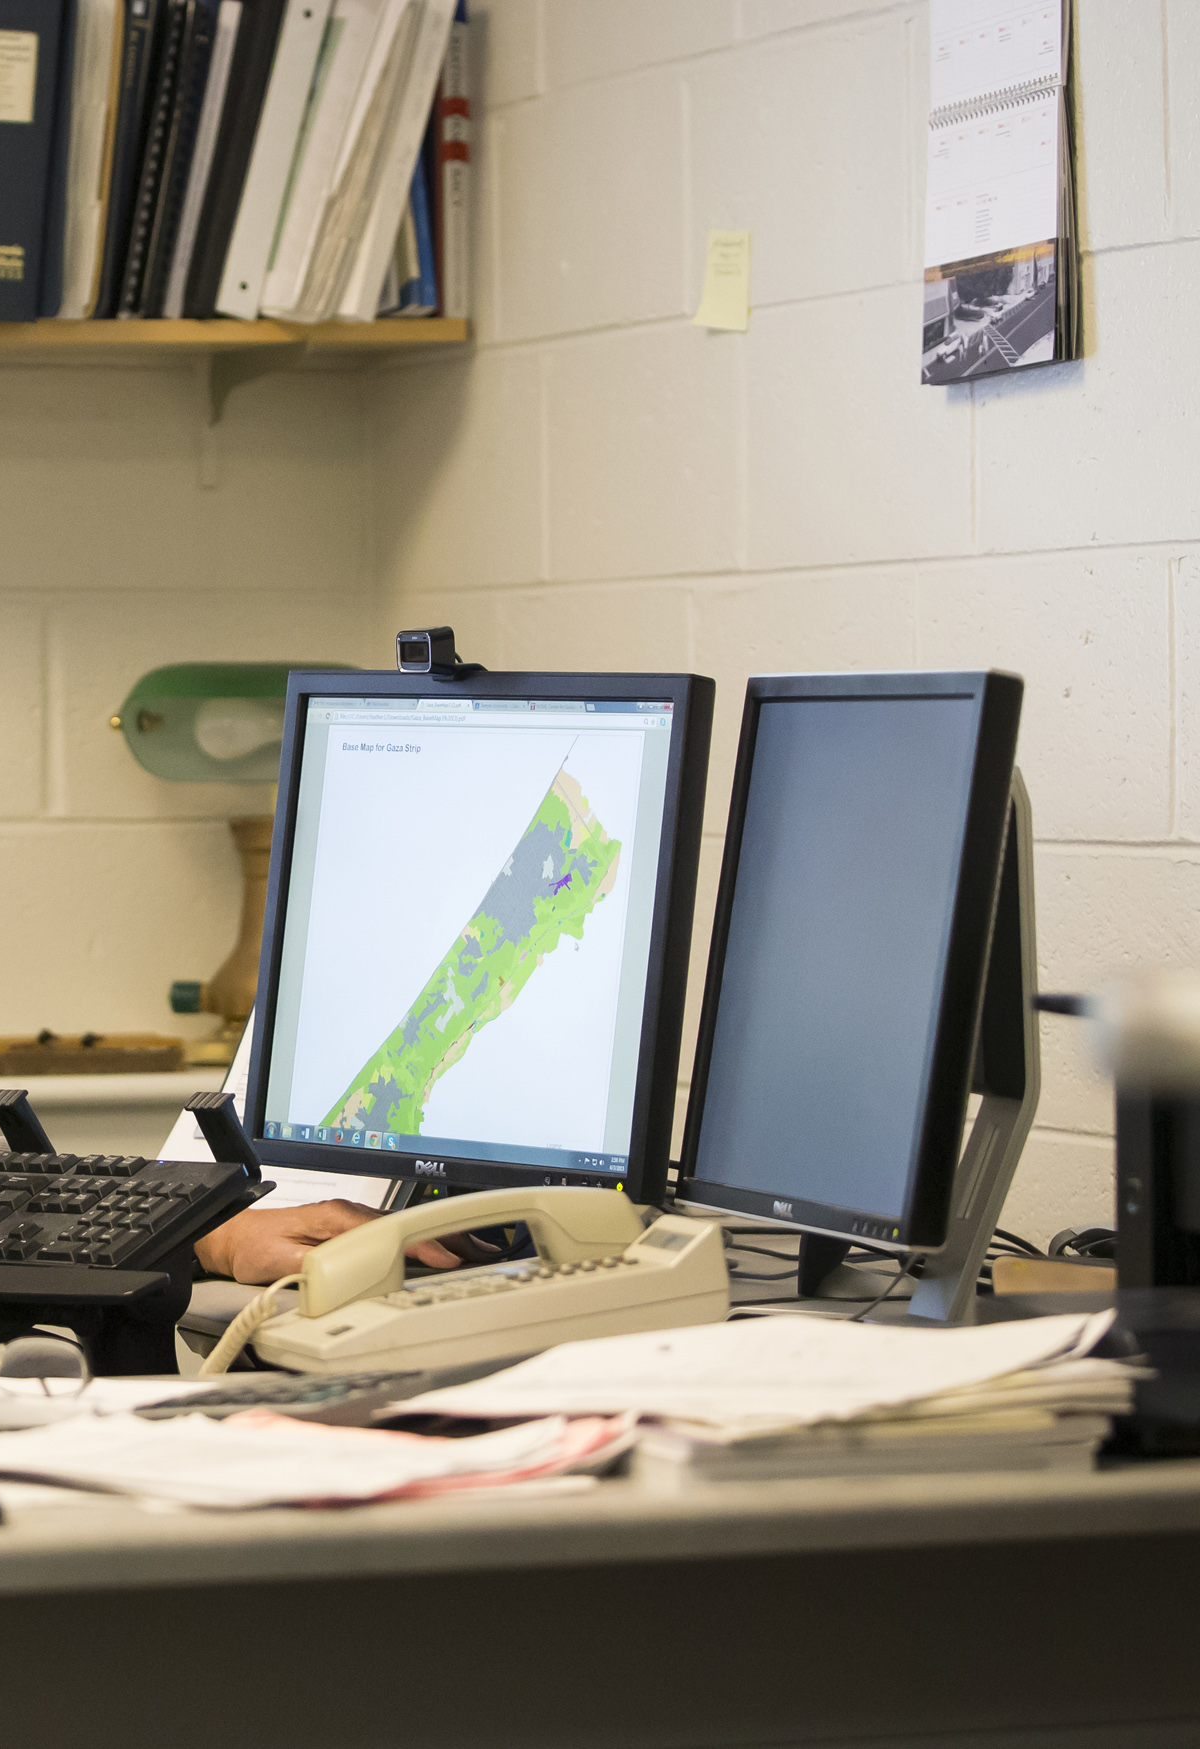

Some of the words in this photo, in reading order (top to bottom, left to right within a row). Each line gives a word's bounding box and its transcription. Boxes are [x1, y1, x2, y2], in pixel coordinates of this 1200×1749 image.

[342, 742, 359, 751] Base
[360, 743, 374, 753] Map
[375, 743, 385, 751] for
[386, 743, 403, 752] Gaza
[405, 744, 421, 754] Strip
[415, 1160, 447, 1177] DELL
